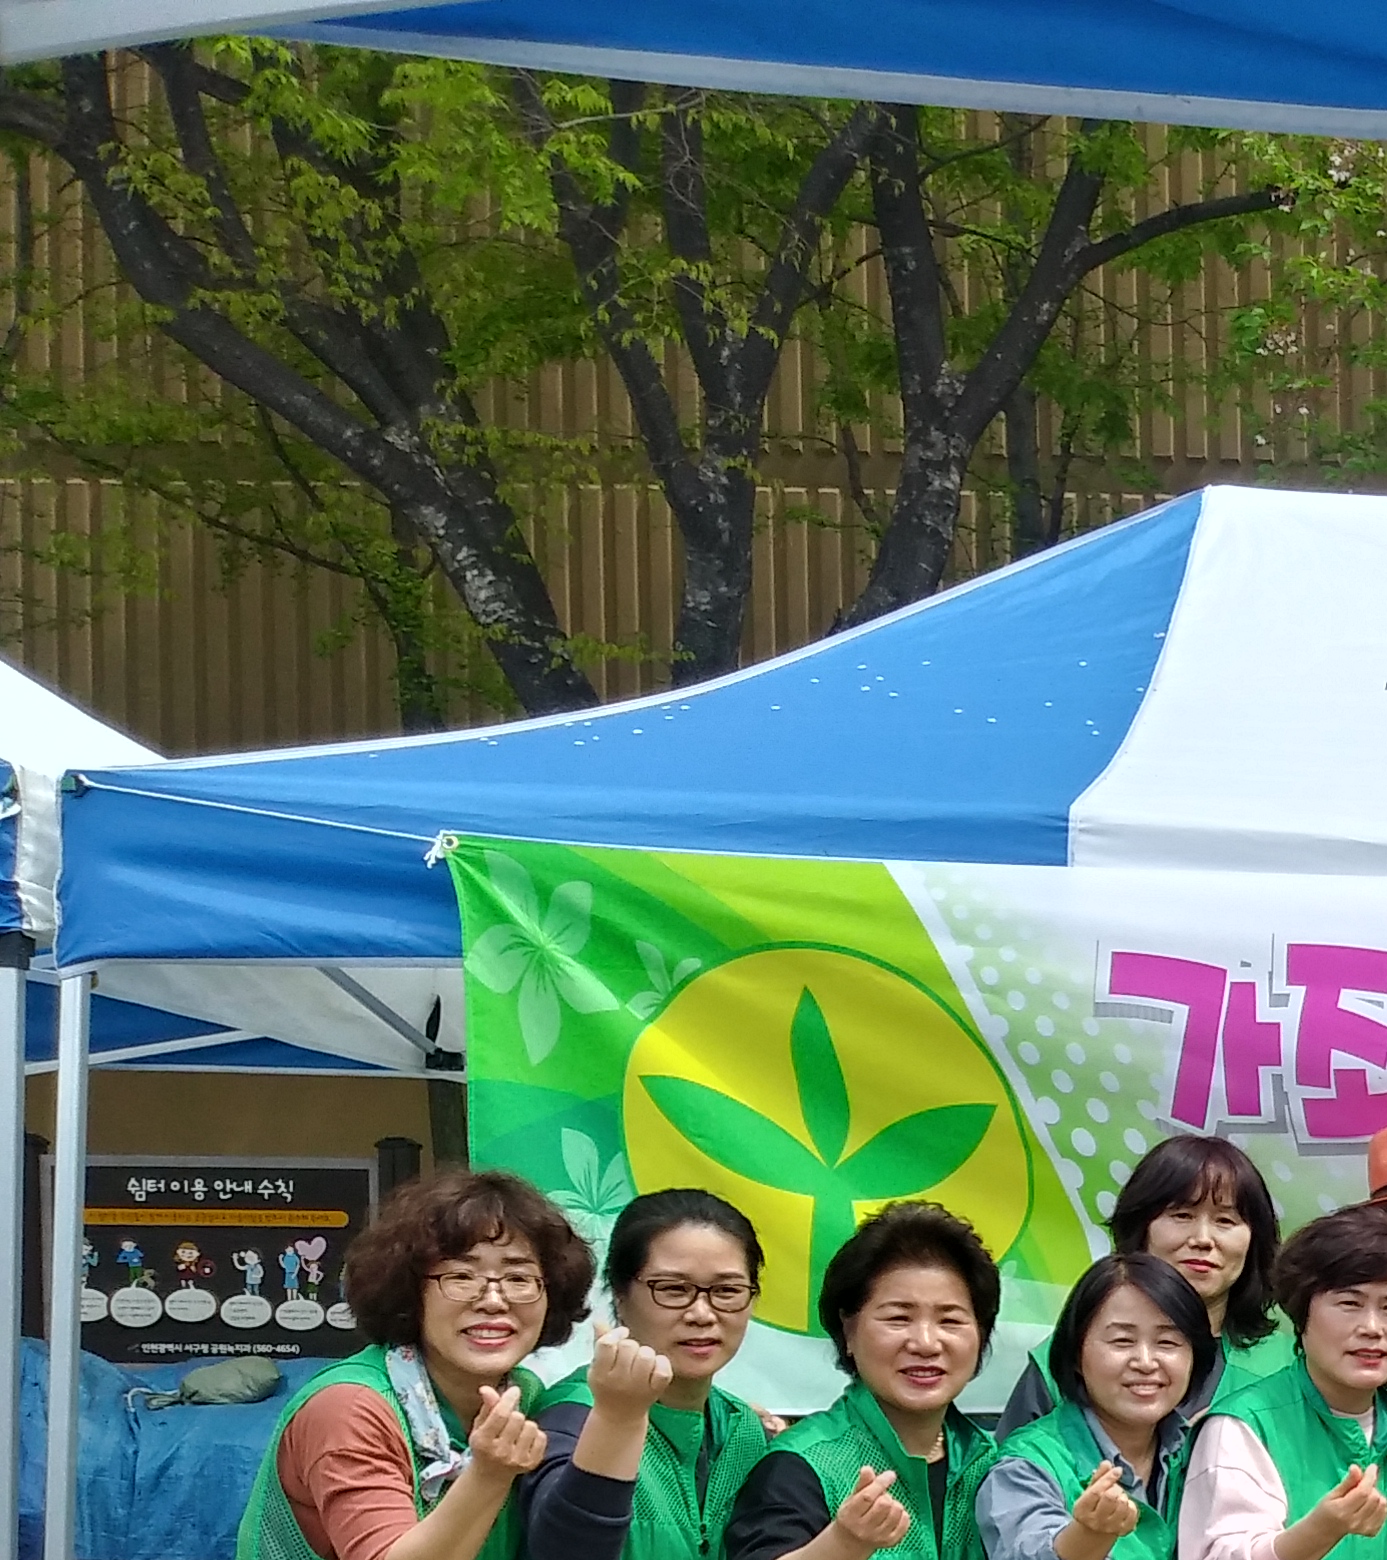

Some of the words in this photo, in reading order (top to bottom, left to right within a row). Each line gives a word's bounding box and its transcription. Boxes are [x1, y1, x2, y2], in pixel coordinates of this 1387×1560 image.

[127, 1177, 166, 1202] 쉼터
[170, 1178, 209, 1201] 이용
[213, 1178, 253, 1200] 안내
[256, 1178, 295, 1203] 수칙
